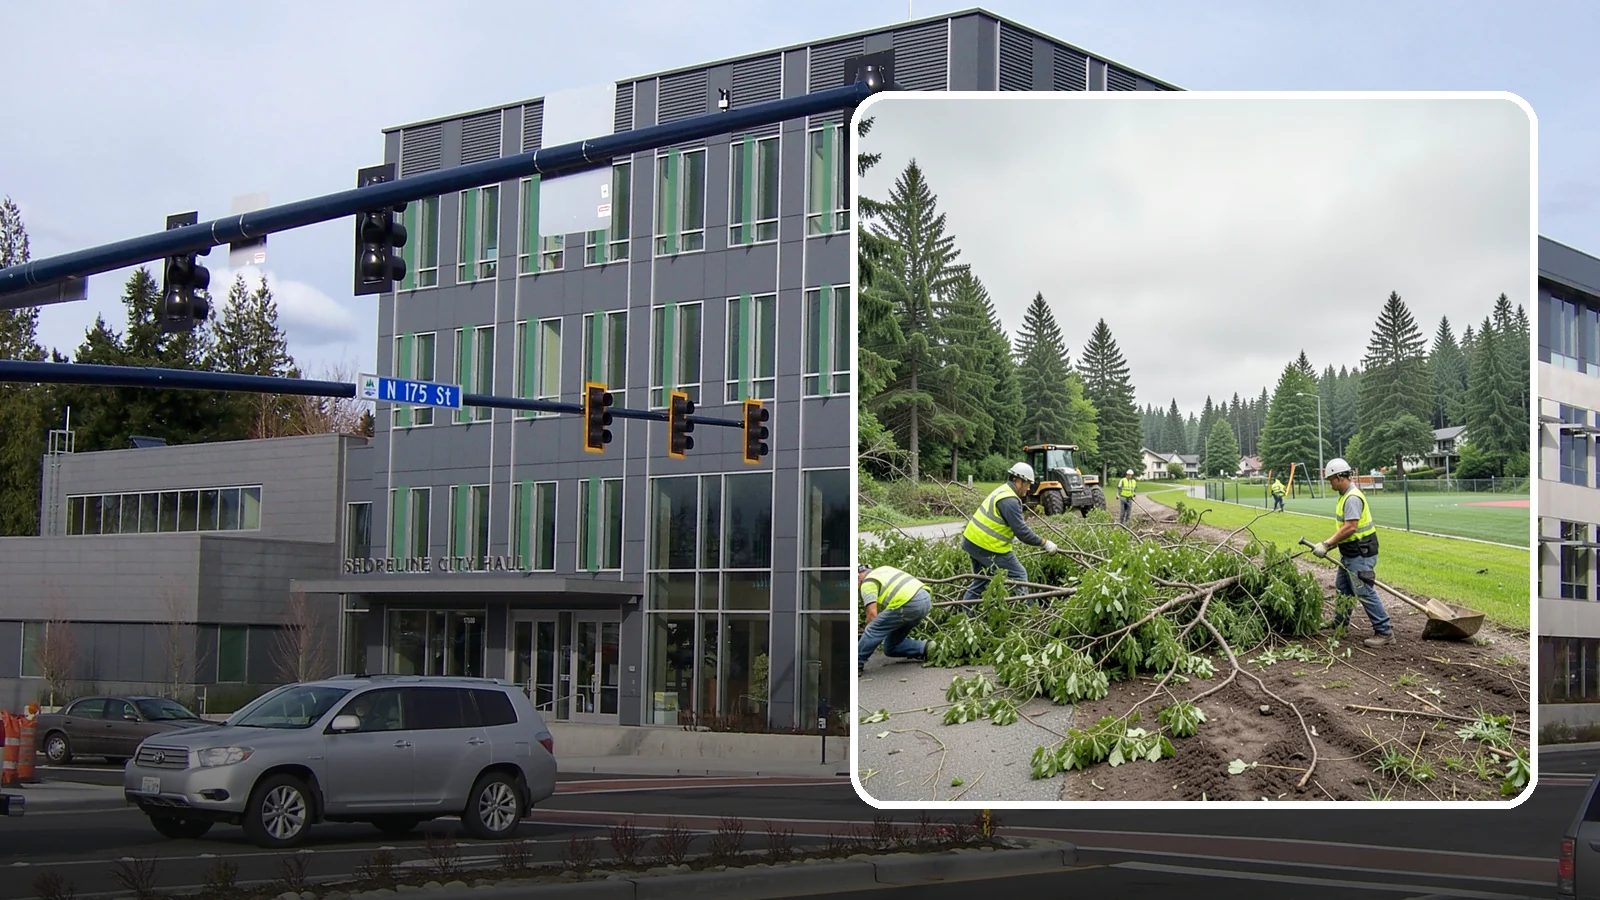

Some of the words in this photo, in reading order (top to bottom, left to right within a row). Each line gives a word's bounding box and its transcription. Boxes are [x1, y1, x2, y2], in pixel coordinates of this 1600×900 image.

[387, 381, 396, 399] N
[405, 383, 427, 403] 175
[436, 387, 451, 405] St
[344, 557, 431, 573] SHORELINE
[438, 556, 475, 572] CITY
[484, 556, 525, 571] HALL
